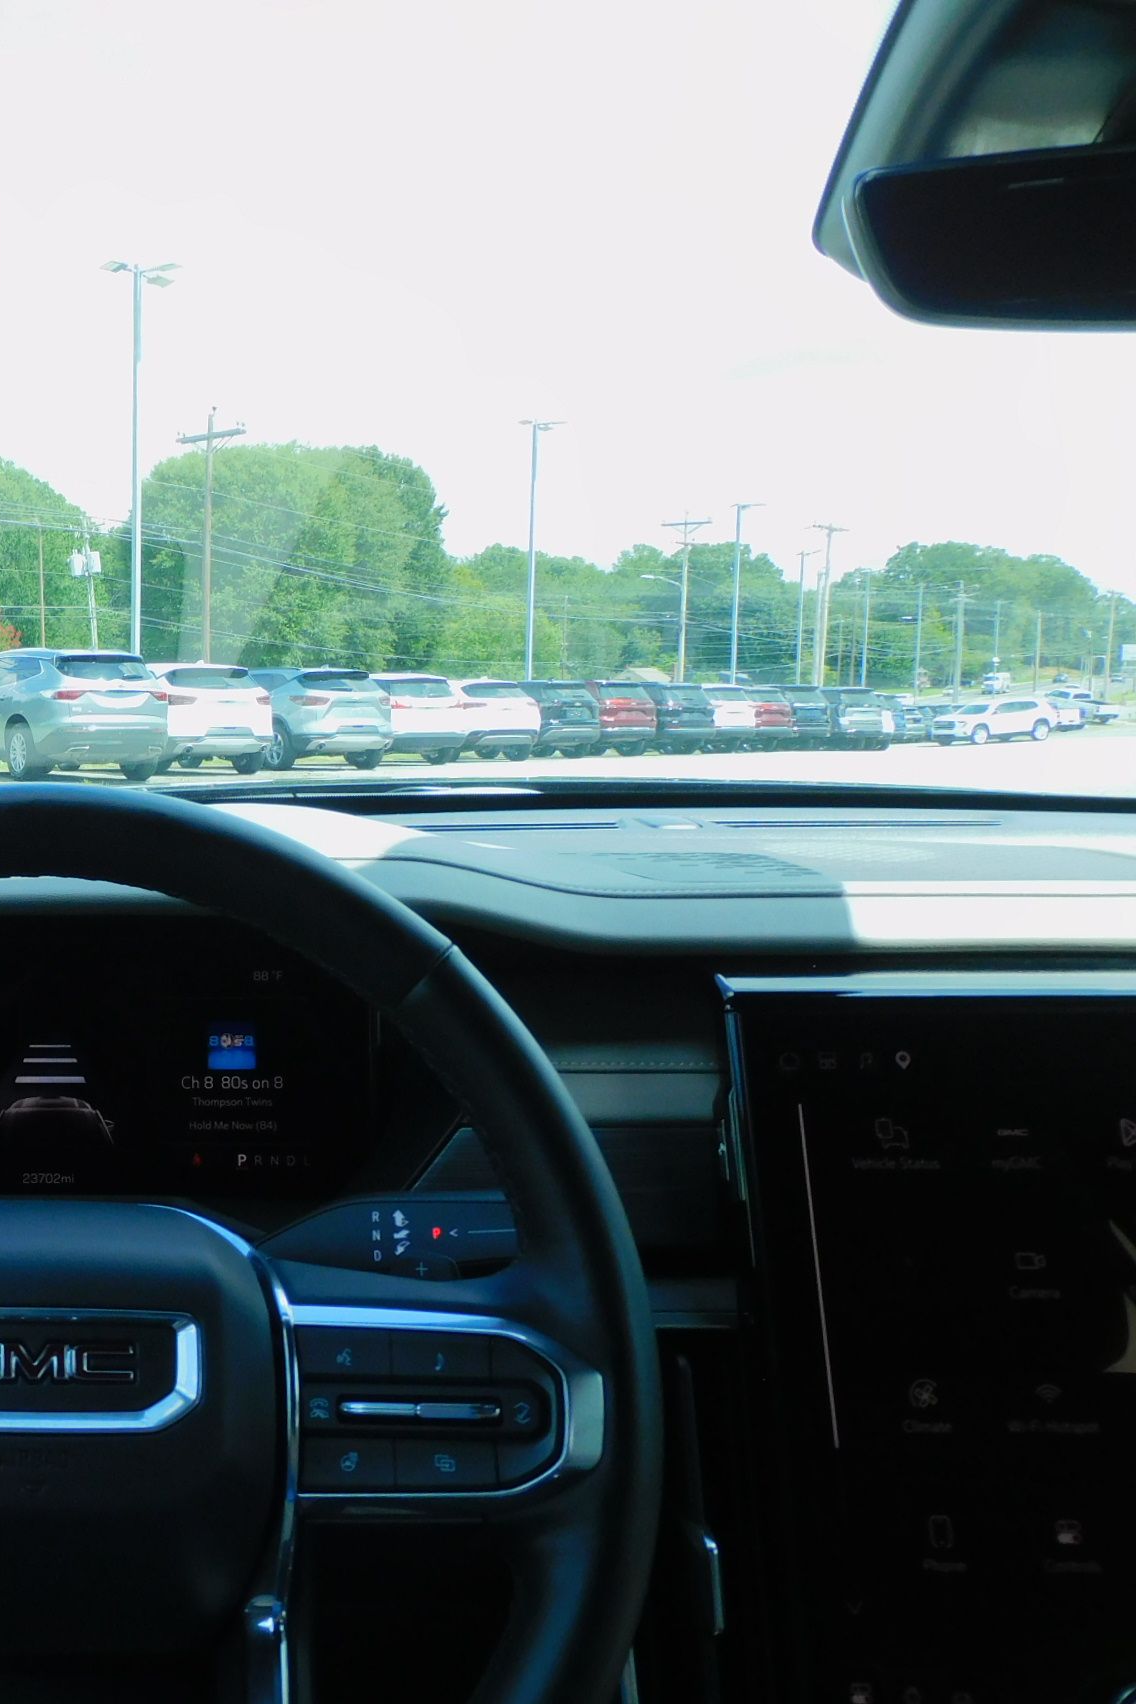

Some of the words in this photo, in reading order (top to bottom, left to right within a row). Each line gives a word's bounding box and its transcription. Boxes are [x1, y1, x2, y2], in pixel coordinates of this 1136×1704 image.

[181, 1075, 200, 1089] Ch
[203, 1076, 214, 1089] 8
[221, 1076, 249, 1089] 80s
[252, 1080, 270, 1089] on
[273, 1076, 284, 1089] 8
[192, 1096, 243, 1108] Thompson
[245, 1096, 273, 1107] Twins
[189, 1120, 212, 1131] Hold
[214, 1121, 229, 1131] Me
[232, 1121, 253, 1131] Now
[255, 1120, 278, 1132] (84)
[237, 1154, 247, 1167] P
[254, 1155, 263, 1166] R
[270, 1155, 279, 1166] N
[287, 1155, 296, 1166] D
[22, 1172, 75, 1185] 23702mi
[371, 1210, 380, 1223] R
[372, 1229, 381, 1241] N
[432, 1226, 442, 1239] P
[373, 1249, 382, 1262] D
